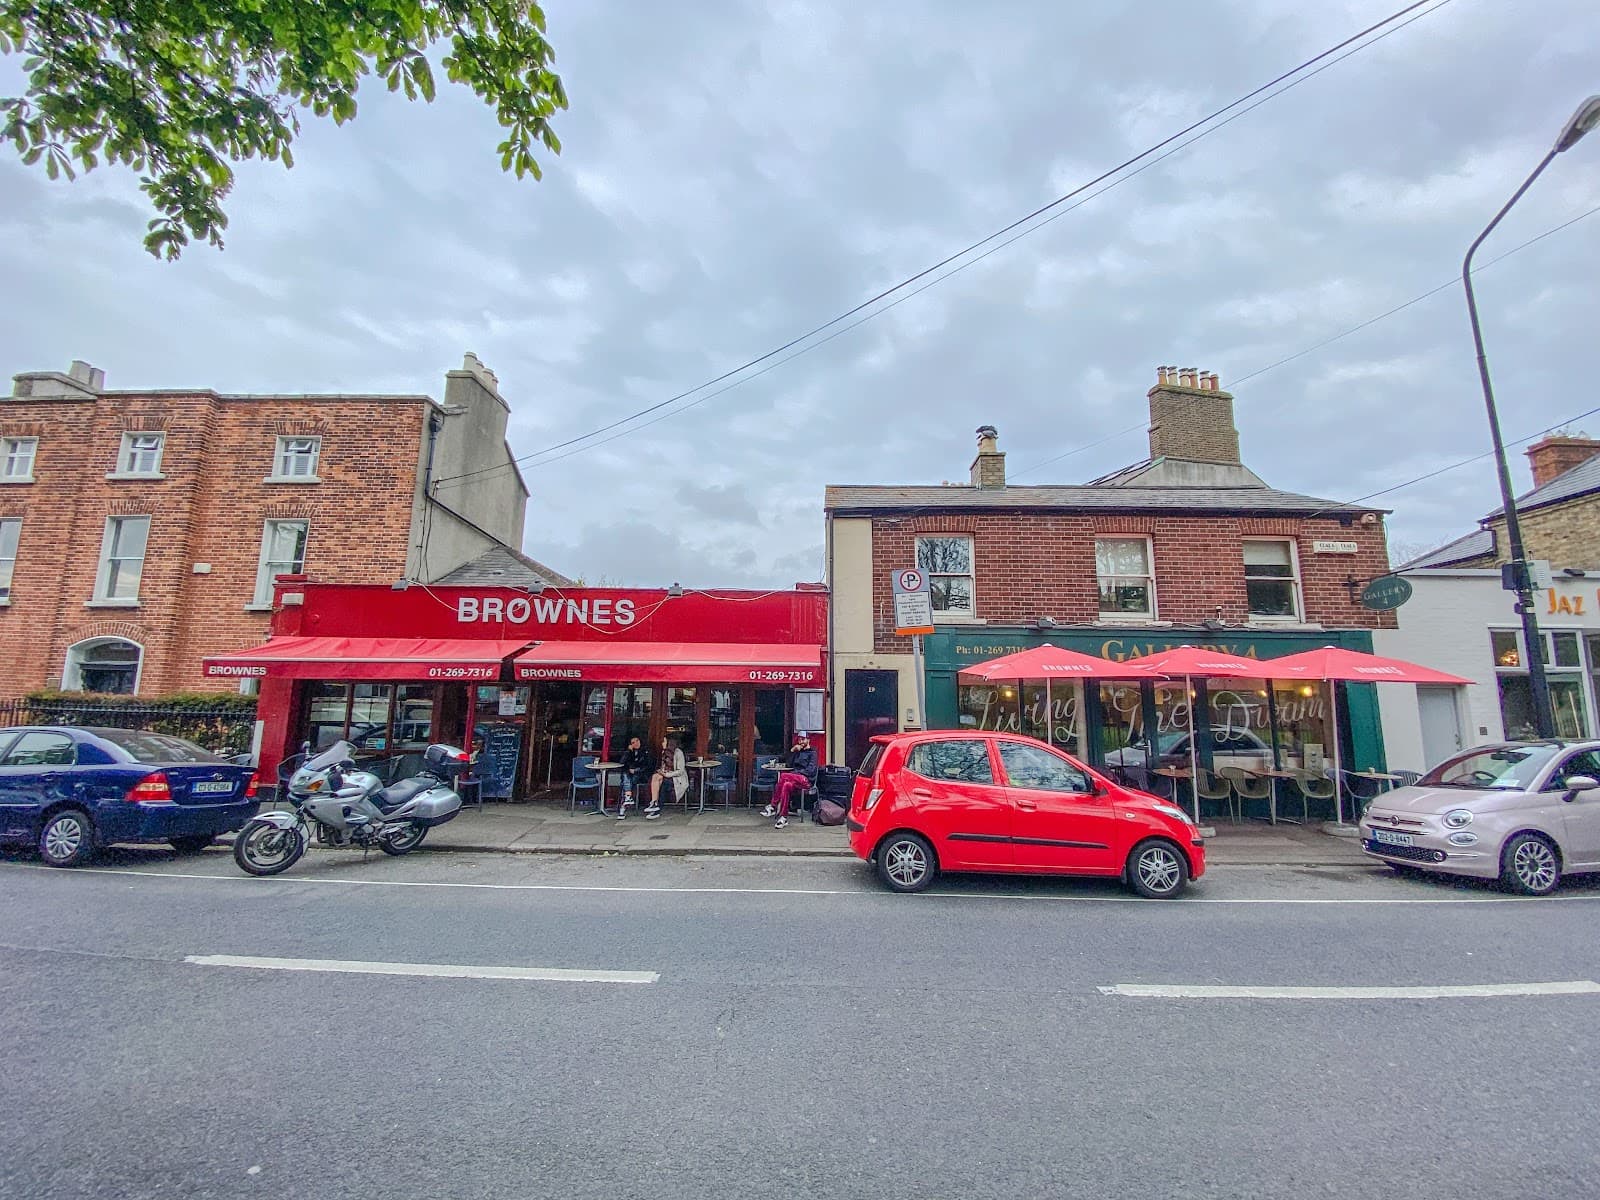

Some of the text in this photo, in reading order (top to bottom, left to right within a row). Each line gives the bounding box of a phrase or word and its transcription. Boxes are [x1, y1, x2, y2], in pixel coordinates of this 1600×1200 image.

[1363, 585, 1407, 600] GALLERY
[1547, 587, 1586, 616] JAZ
[457, 597, 635, 625] BROWNES
[956, 646, 971, 655] Ph:
[973, 646, 1004, 655] 01-269
[208, 665, 267, 676] BROWNES
[429, 667, 493, 678] 01-269-7316
[520, 668, 582, 678] BROWNES
[749, 670, 814, 681] 01-269-7316
